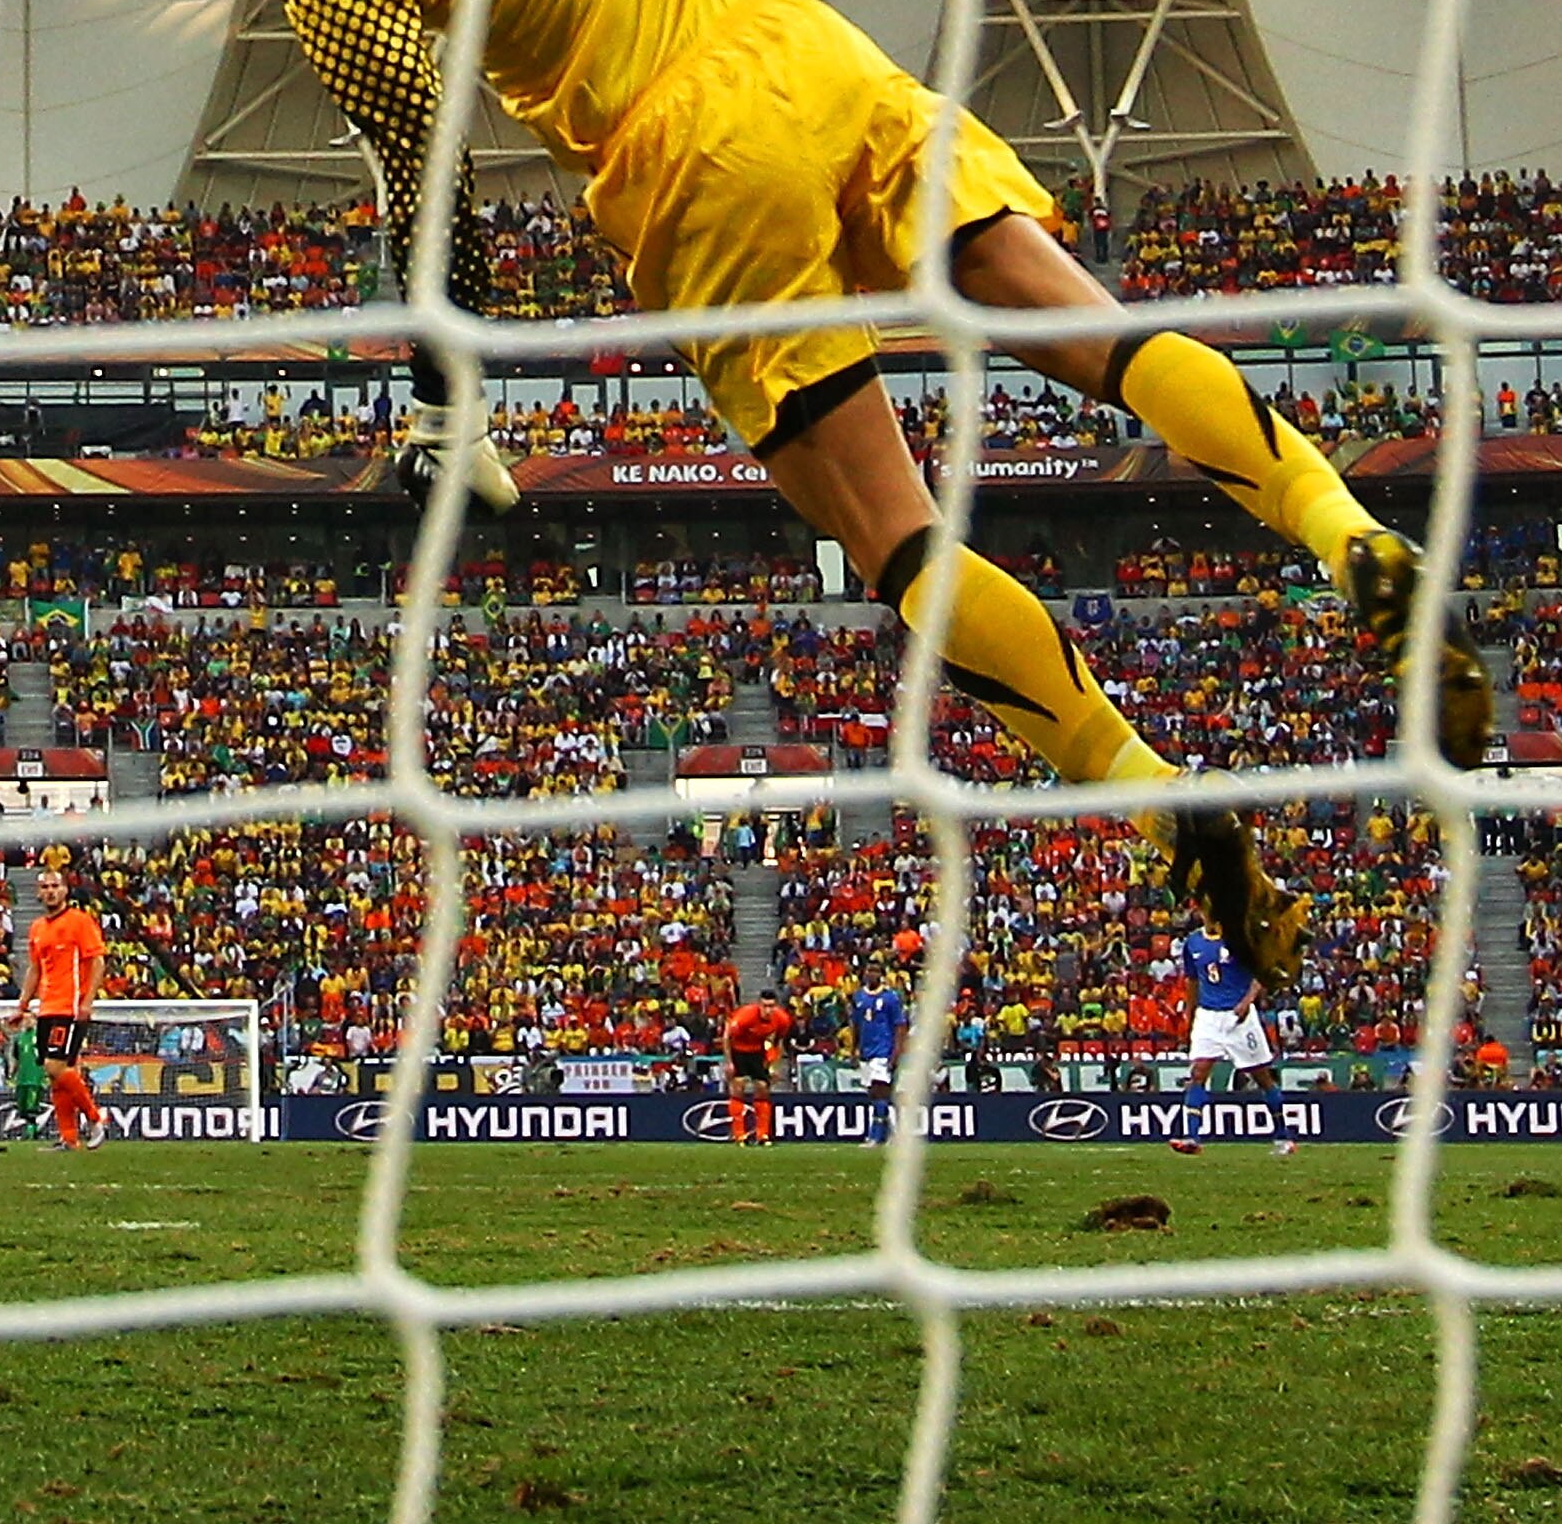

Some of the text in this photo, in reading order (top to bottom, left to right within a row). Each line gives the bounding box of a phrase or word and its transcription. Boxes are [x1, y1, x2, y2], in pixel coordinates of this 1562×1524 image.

[612, 464, 642, 483] KE
[648, 464, 724, 483] NAKO.
[1246, 1032, 1258, 1051] 8
[80, 1106, 280, 1138] YUNDAI
[427, 1106, 628, 1137] HYUNDAI
[774, 1104, 975, 1136] HYUAI
